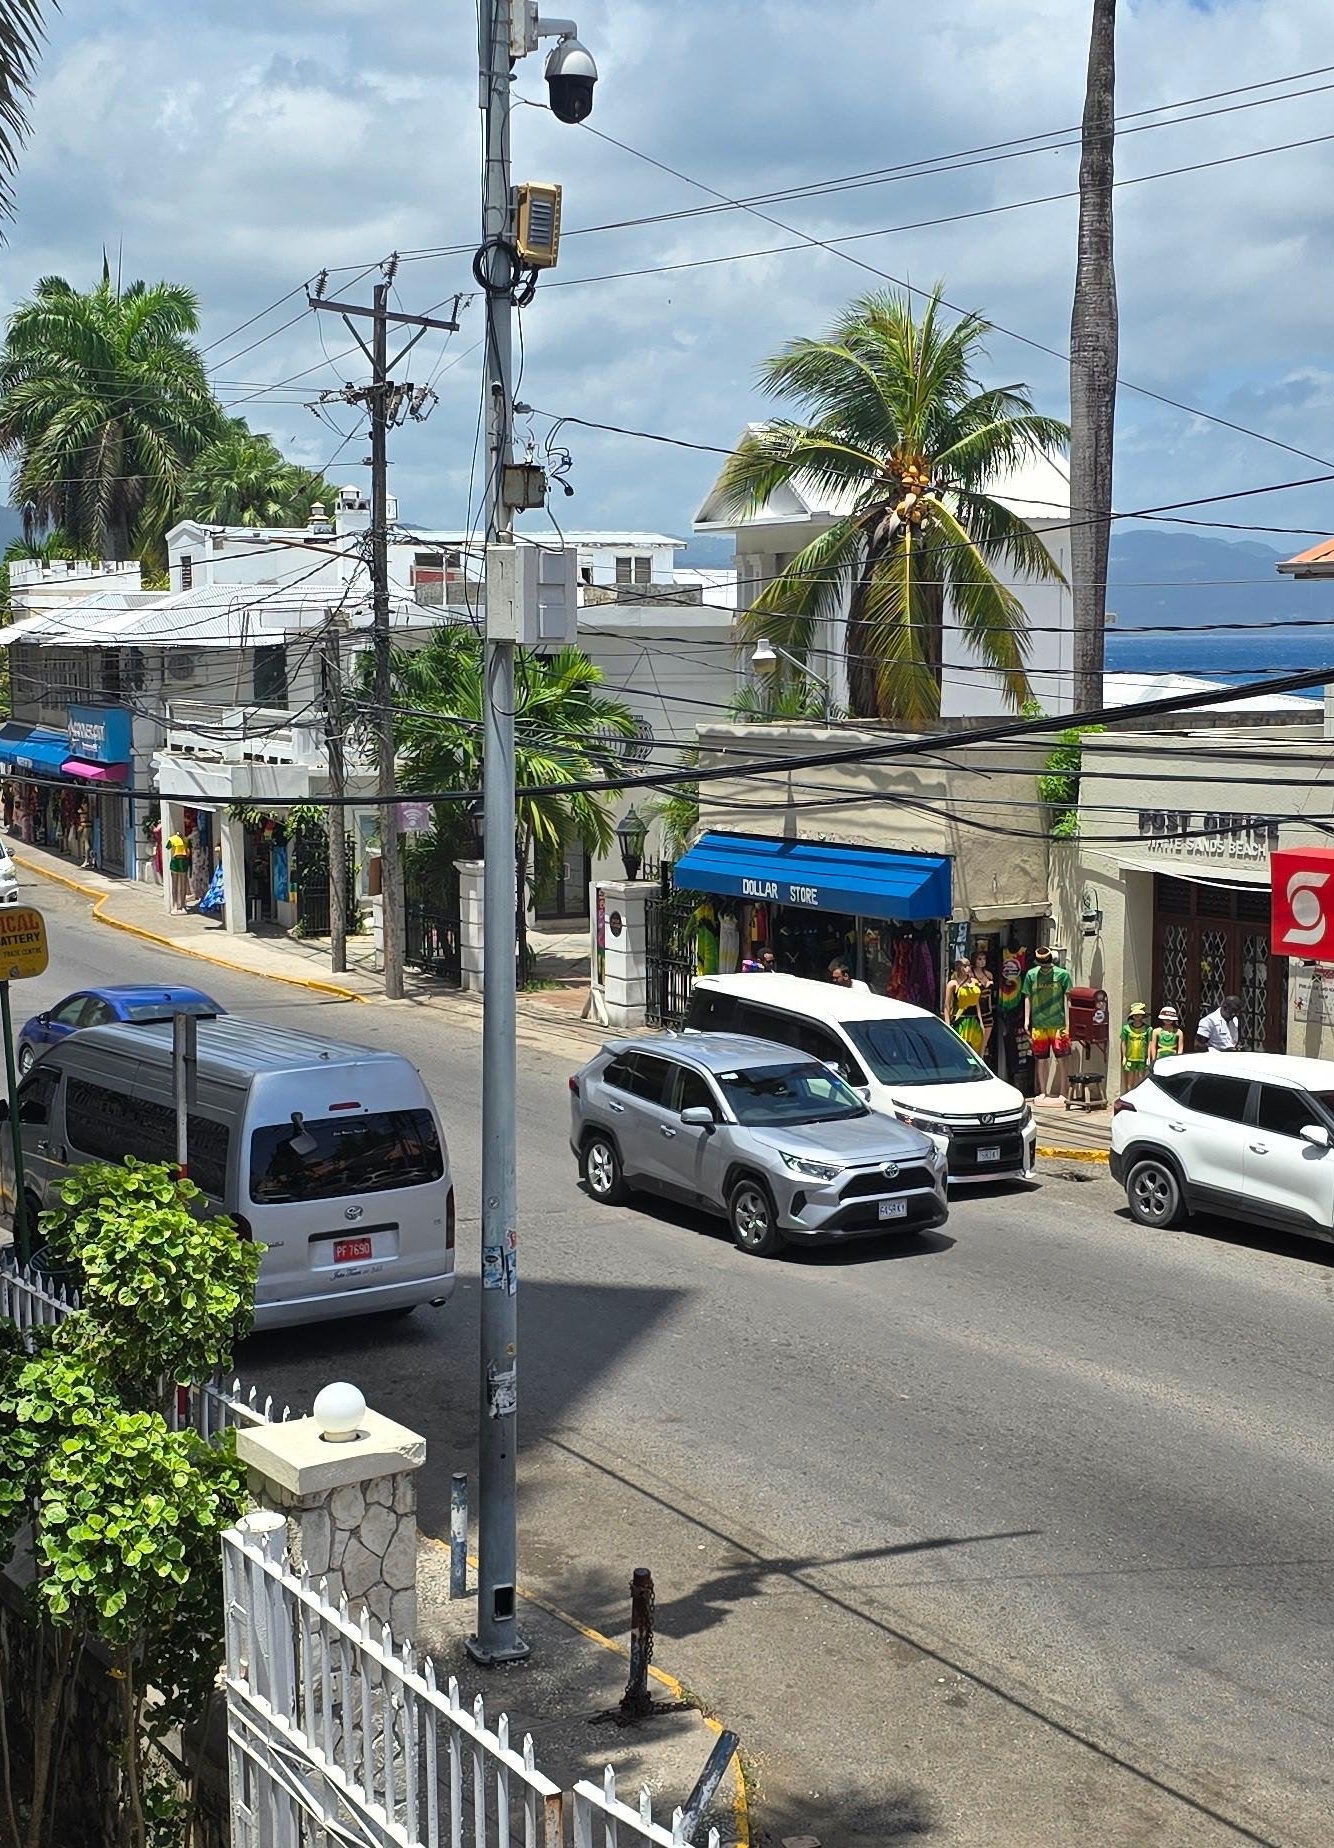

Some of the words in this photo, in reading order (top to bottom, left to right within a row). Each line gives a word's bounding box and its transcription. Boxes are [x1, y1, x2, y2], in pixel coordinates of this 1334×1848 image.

[1138, 810, 1190, 834] POST
[1186, 838, 1224, 853] SANDS
[1229, 841, 1267, 857] BEACH
[742, 878, 779, 899] DOLLAR
[789, 885, 819, 905] STORE
[336, 1246, 348, 1258] PF
[349, 1243, 370, 1256] 7690
